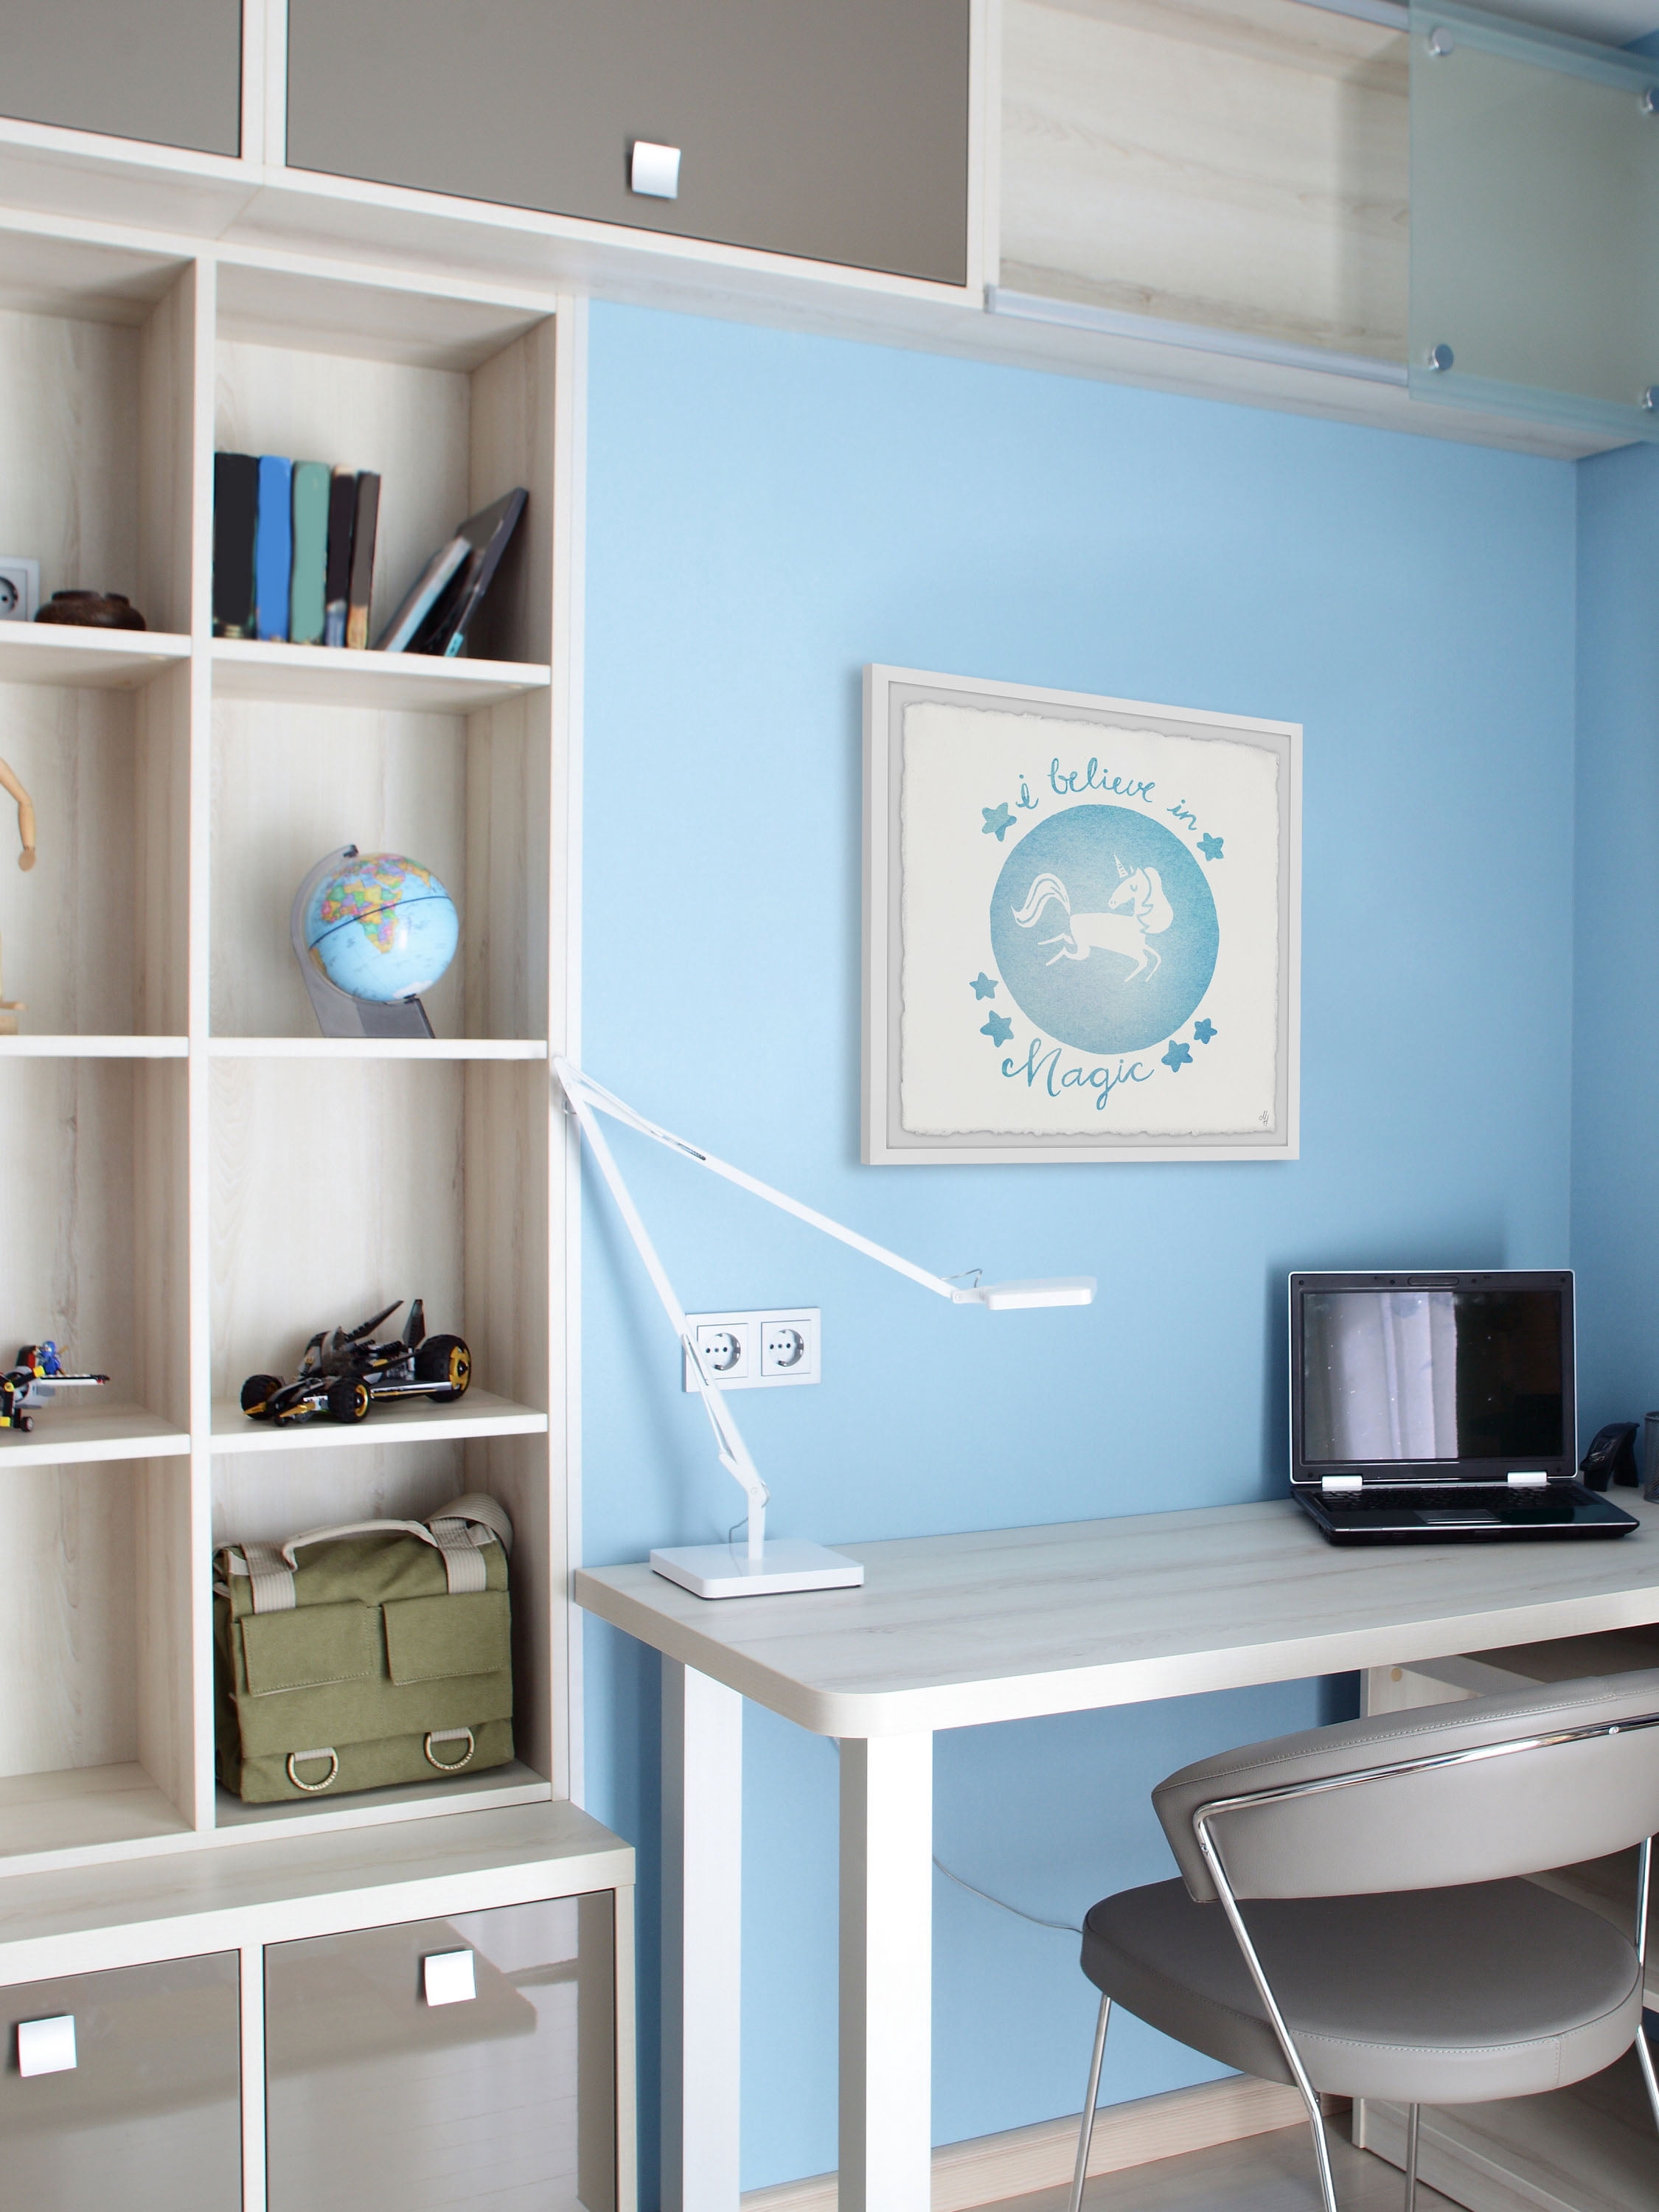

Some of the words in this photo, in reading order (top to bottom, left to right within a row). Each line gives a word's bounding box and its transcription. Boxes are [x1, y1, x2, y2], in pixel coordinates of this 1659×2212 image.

[1048, 757, 1155, 802] believe
[1166, 799, 1197, 830] in
[1001, 1037, 1154, 1110] Magic
